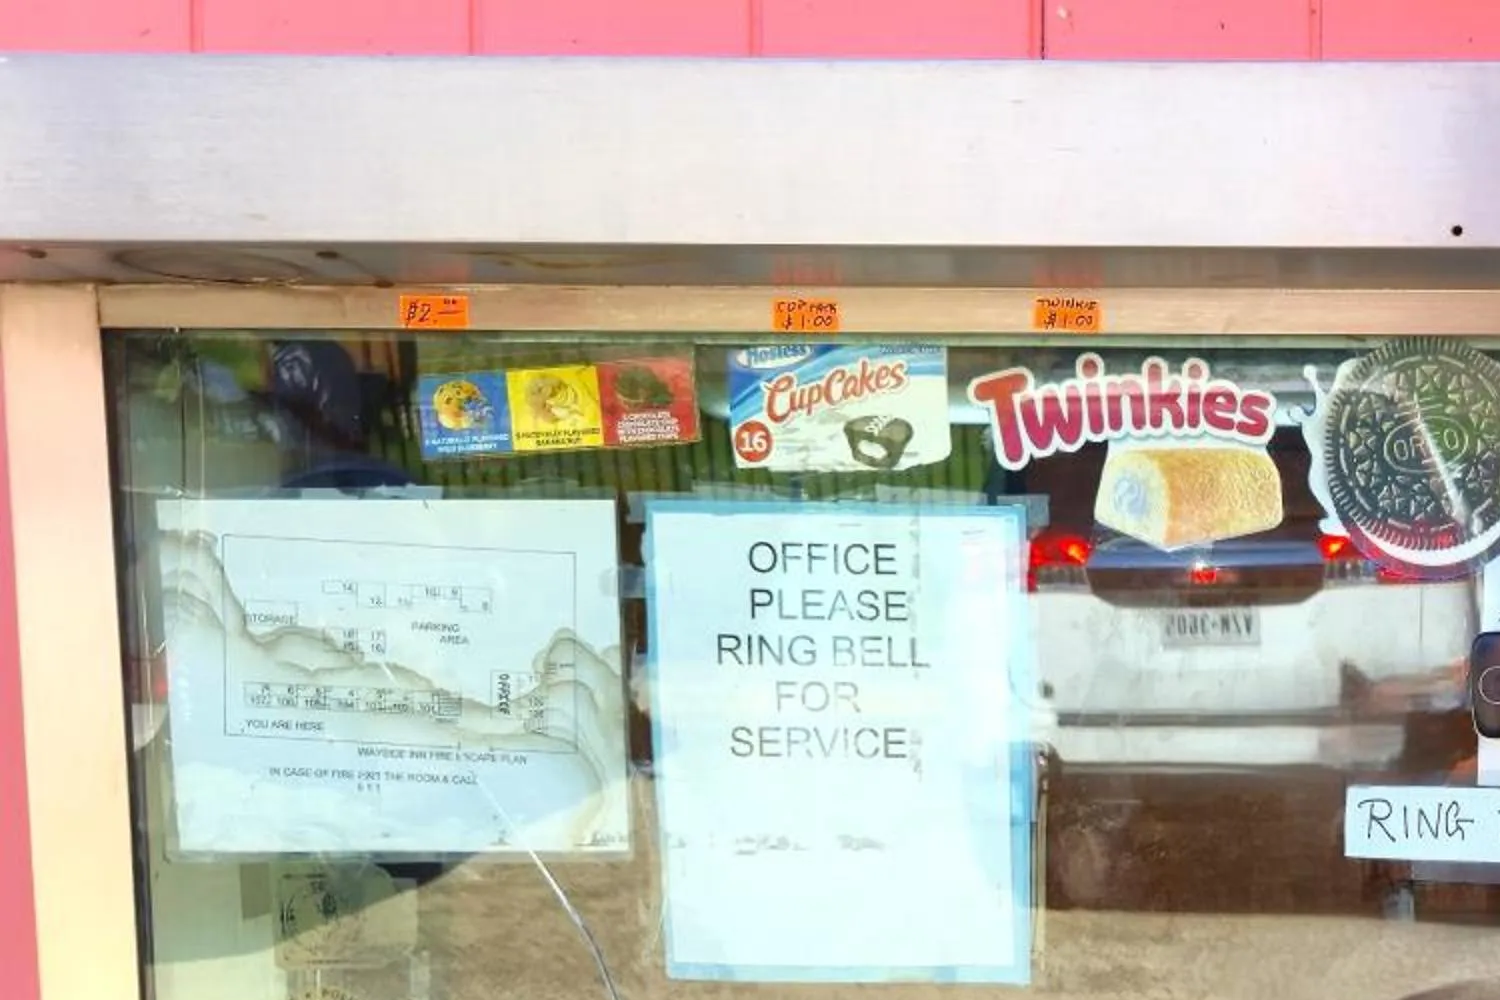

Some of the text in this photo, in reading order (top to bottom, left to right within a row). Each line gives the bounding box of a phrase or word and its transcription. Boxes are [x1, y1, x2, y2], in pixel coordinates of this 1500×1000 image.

[763, 358, 907, 424] CupCakes
[970, 355, 1274, 466] Twinkies
[740, 432, 768, 452] 16
[748, 542, 899, 575] OFFICE
[751, 589, 909, 622] PLEASE
[717, 634, 931, 668] RING BELL
[776, 681, 861, 713] FOR
[246, 718, 324, 732] YOU ARE HERE
[730, 726, 908, 760] SERVICE
[1357, 799, 1475, 843] RING
